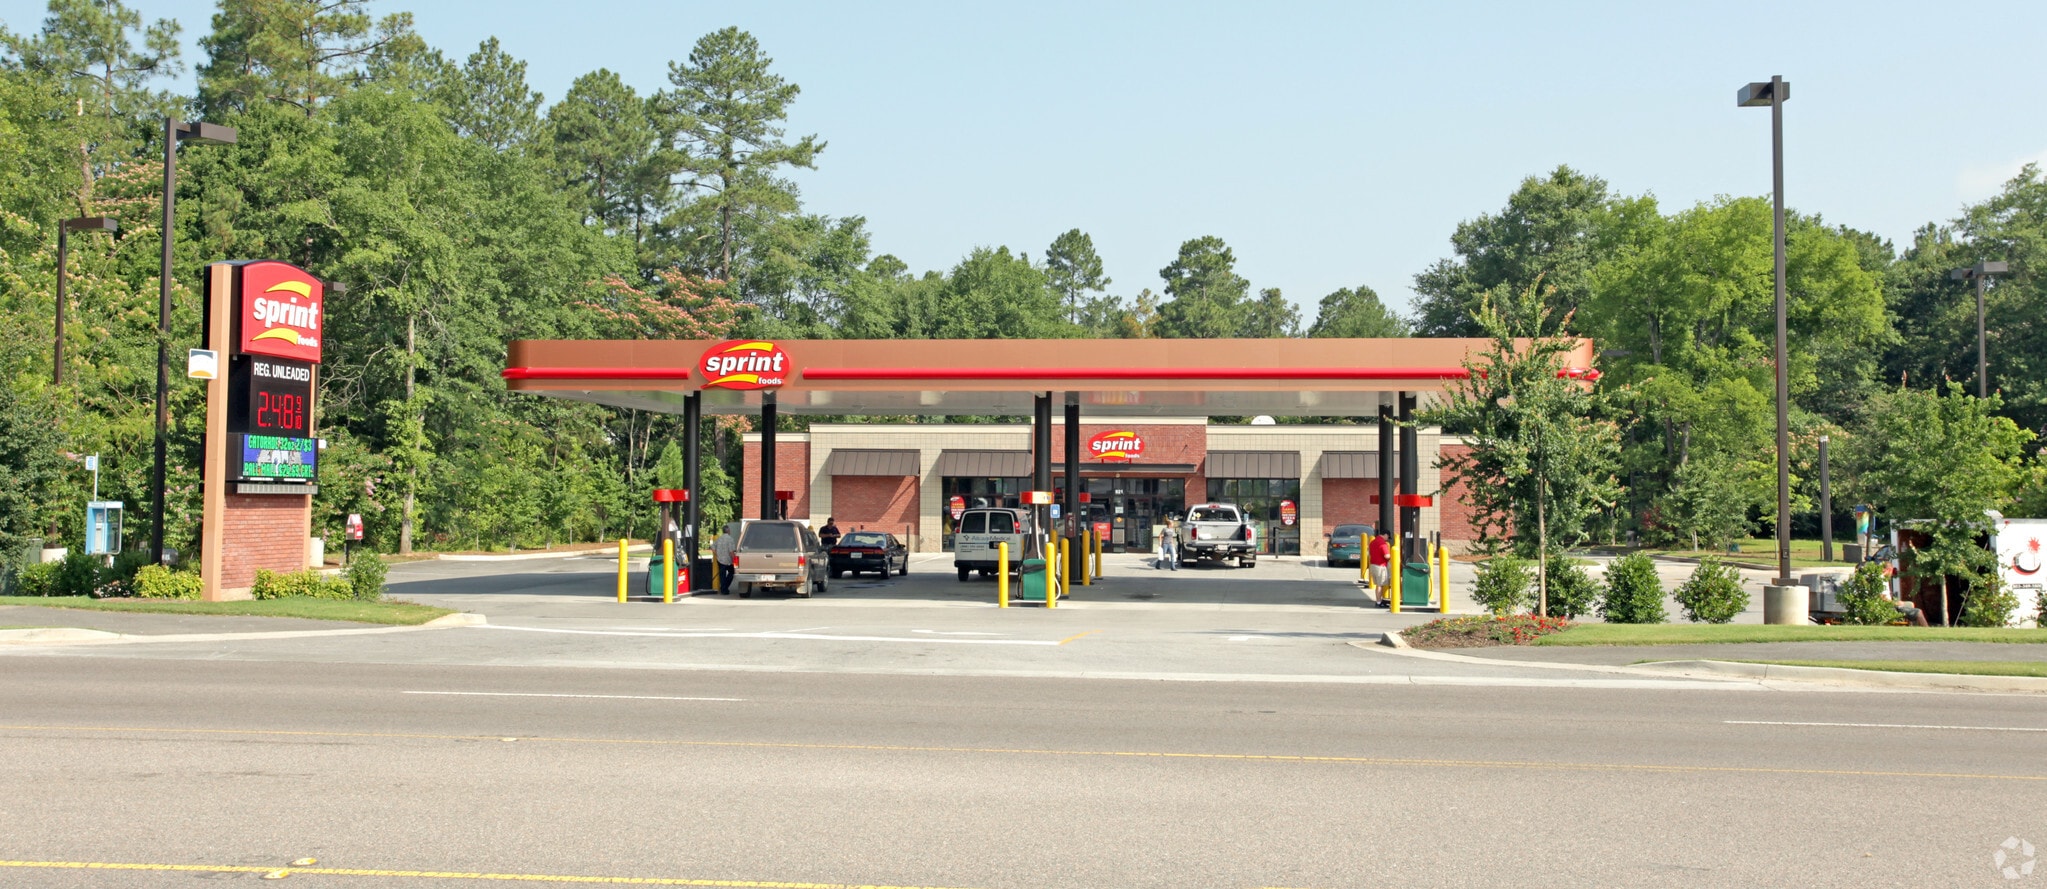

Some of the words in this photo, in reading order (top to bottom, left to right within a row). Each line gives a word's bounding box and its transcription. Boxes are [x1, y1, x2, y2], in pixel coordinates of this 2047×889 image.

[253, 297, 318, 330] sprint
[297, 334, 318, 347] foods
[253, 362, 271, 377] REG.
[272, 364, 310, 382] UNLEADED
[705, 352, 784, 376] sprint
[257, 391, 294, 429] 2.48
[1092, 437, 1141, 453] sprint
